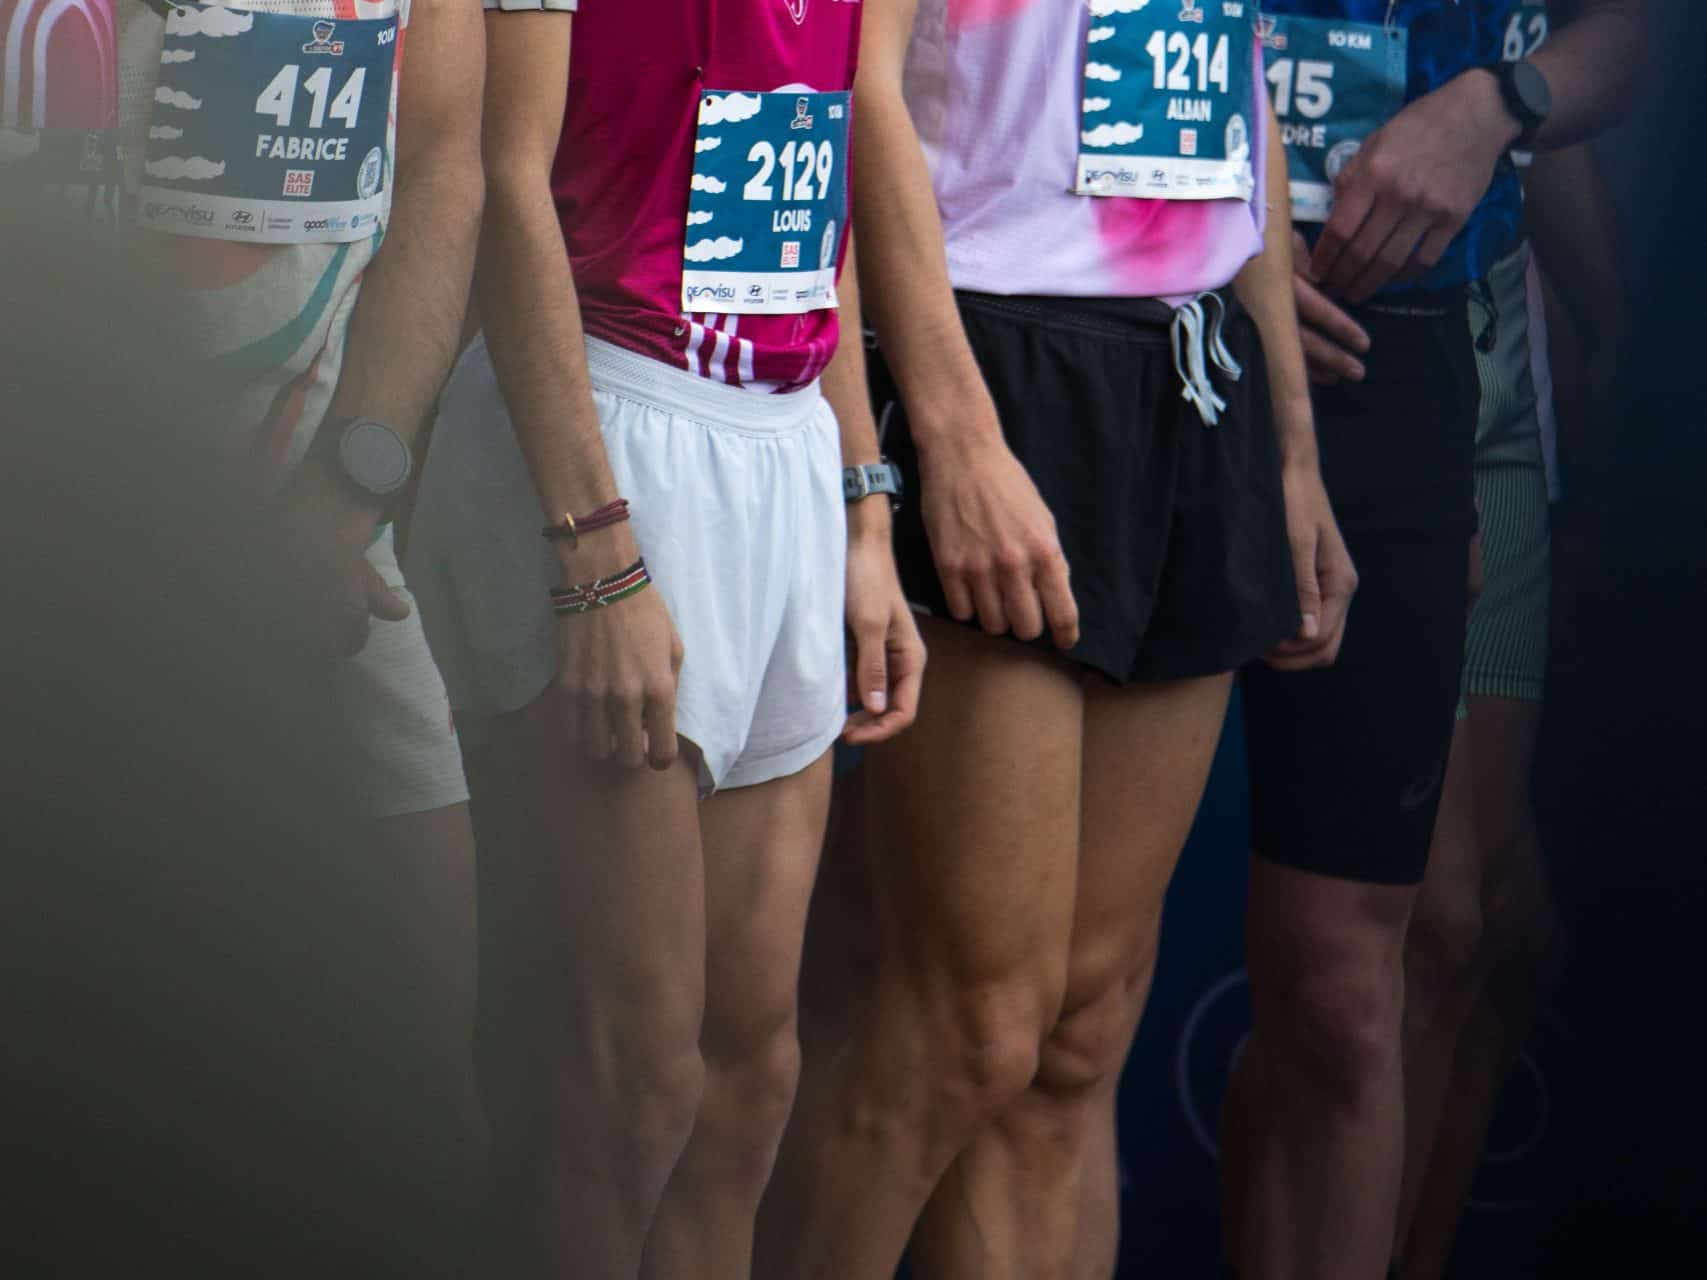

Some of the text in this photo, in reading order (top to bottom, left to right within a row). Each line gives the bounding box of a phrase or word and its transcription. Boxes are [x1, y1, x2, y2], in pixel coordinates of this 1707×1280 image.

[1328, 29, 1372, 50] 10 KM
[1145, 30, 1229, 93] 1214
[255, 63, 367, 129] 414
[1266, 58, 1334, 119] 15
[255, 134, 349, 161] FABRICE
[287, 172, 312, 184] SAS
[743, 140, 833, 201] 2129
[286, 184, 311, 194] ELITE
[772, 210, 811, 233] LOUIS
